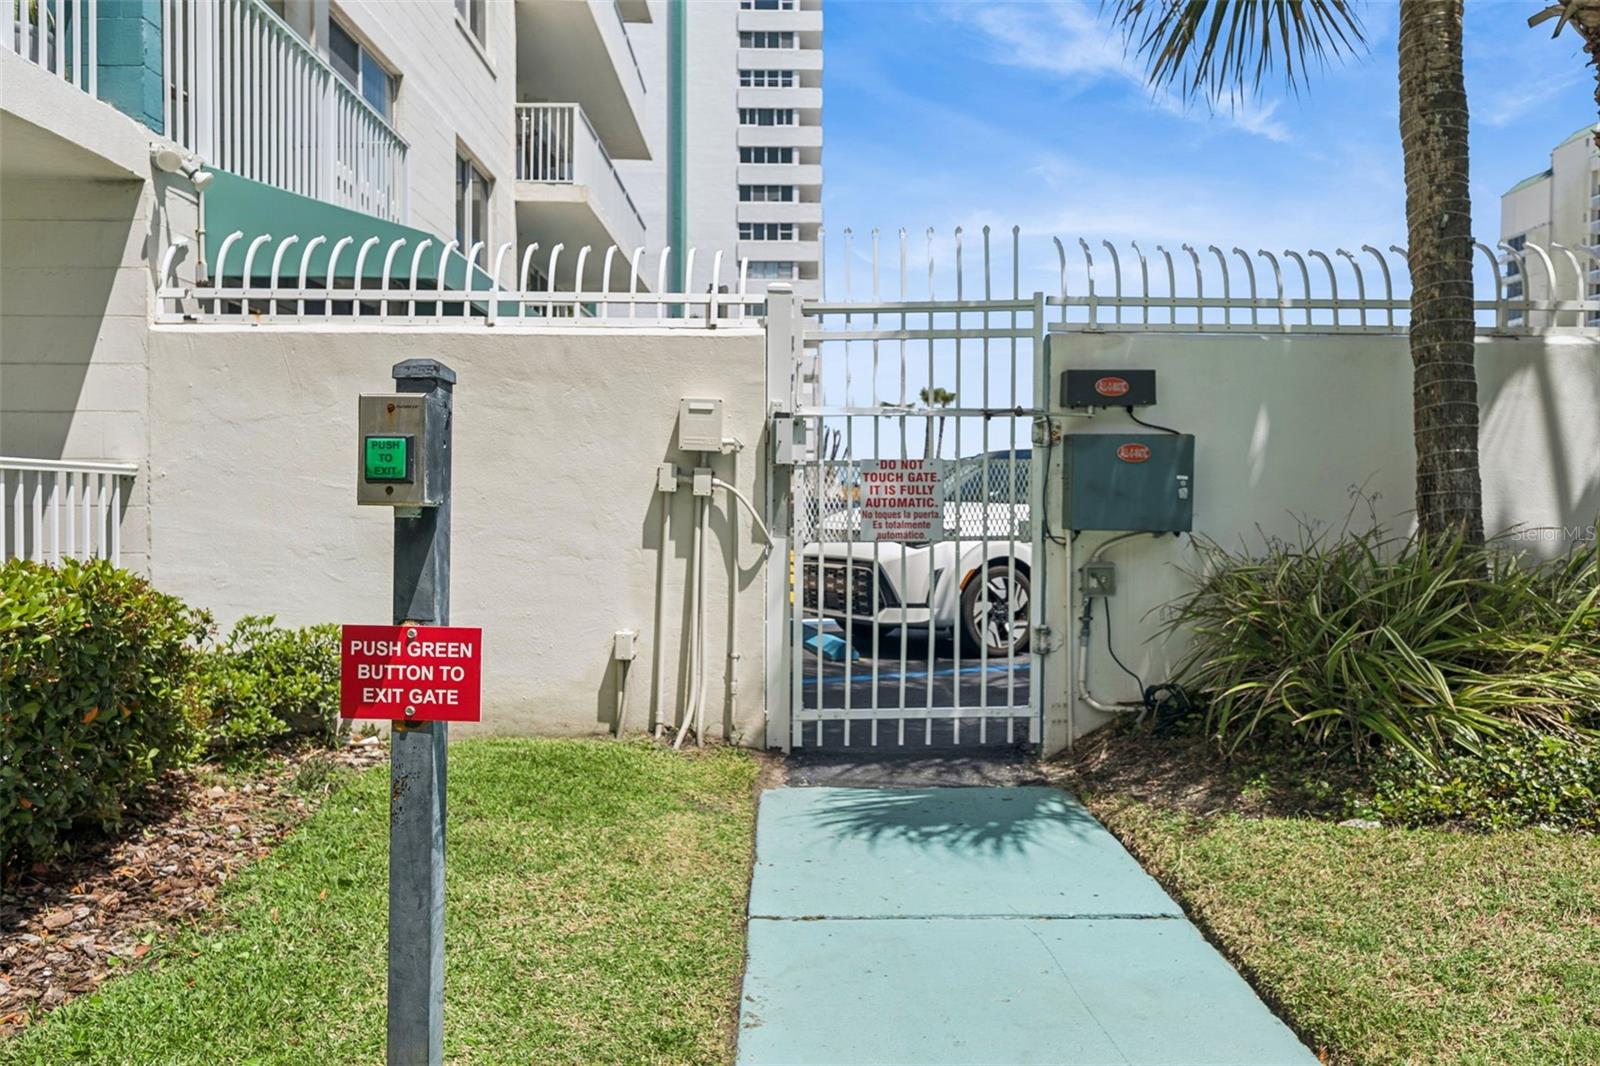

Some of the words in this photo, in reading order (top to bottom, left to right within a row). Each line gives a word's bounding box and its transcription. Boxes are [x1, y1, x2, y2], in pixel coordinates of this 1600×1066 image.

[371, 440, 400, 450] PUSH
[378, 453, 393, 462] TO
[880, 460, 896, 470] DO
[900, 460, 924, 470] NOT
[374, 466, 398, 476] EXIT
[862, 472, 904, 482] TOUCH
[908, 472, 941, 482] GATE.
[870, 485, 880, 495] IT
[884, 485, 896, 495] IS
[900, 485, 934, 495] FULLY
[865, 498, 938, 508] AUTOMATIC.
[862, 510, 873, 518] No
[875, 511, 902, 520] toques
[904, 510, 911, 518] la
[872, 520, 882, 529] Es
[885, 520, 931, 529] totalmente
[350, 640, 402, 656] PUSH
[407, 641, 472, 658] GREEN
[358, 664, 434, 680] BUTTON
[439, 666, 465, 682] TO
[362, 687, 404, 704] EXIT
[408, 688, 459, 705] GATE
